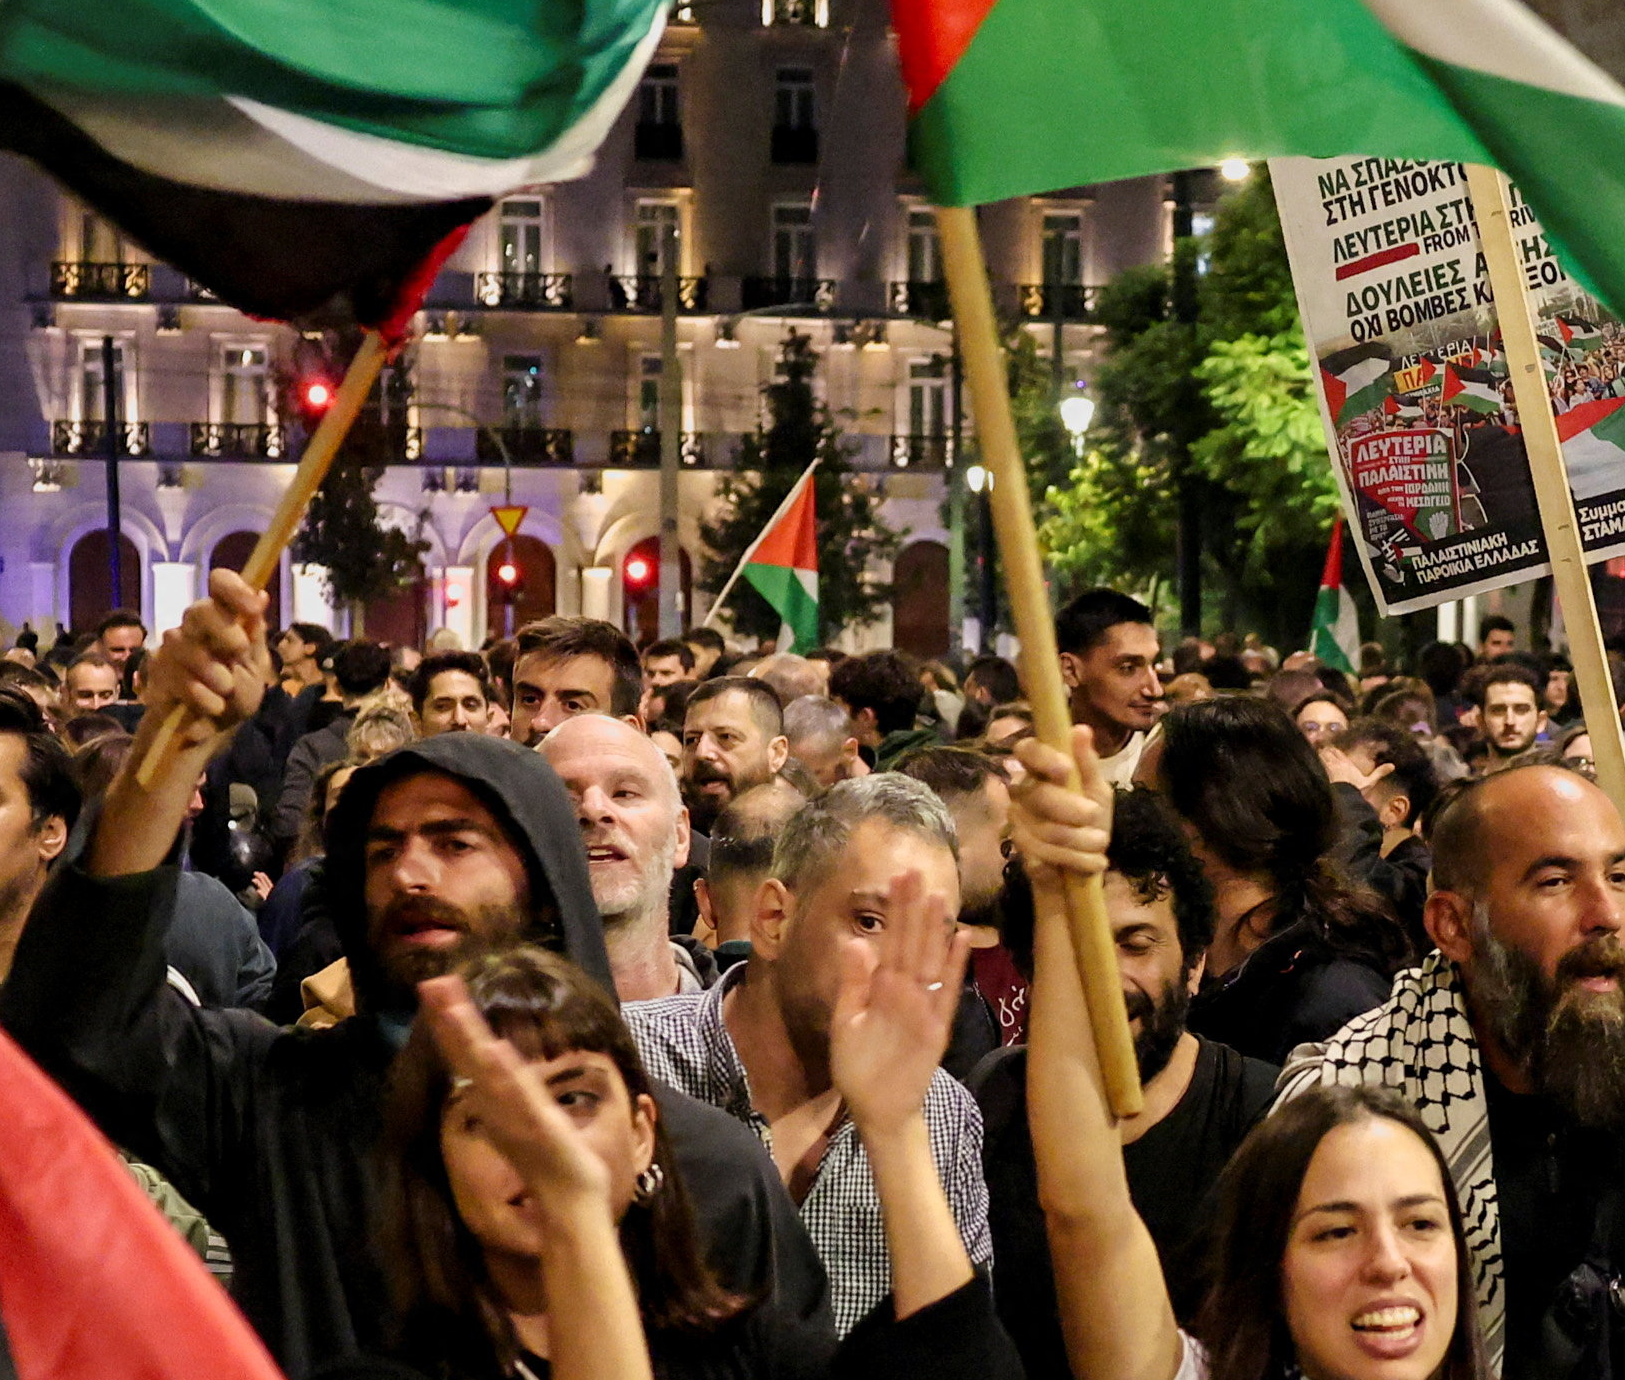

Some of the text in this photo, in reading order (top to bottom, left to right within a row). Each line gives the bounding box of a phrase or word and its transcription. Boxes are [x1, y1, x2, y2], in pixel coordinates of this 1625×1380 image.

[1318, 168, 1352, 199] ΝΑ
[1322, 184, 1366, 227] ΣΤΗ
[1333, 209, 1436, 264] ΛΕΥΤΕΡΙΑ
[1424, 225, 1471, 255] FROM
[1346, 259, 1465, 318] ΔΟΥΛΕΙΕΣ
[1350, 313, 1384, 343] ΟΧΙ
[1385, 286, 1472, 333] ΒΟΜΒΕΣ
[1401, 339, 1473, 370] ΛΕΕΡΙΑ
[1356, 435, 1448, 464] ΛΕΥΤΕΡΙΑ
[1358, 462, 1449, 488] ΠΑΛΑΙΣΤΙΝΗ
[1411, 531, 1508, 570] ΠΑΛΑΙΣΤΙΝΙΑΚΗ
[1416, 539, 1540, 585] ΠΑΡΟΙΚΙΑ ΕΛΛΑΔΑΣ
